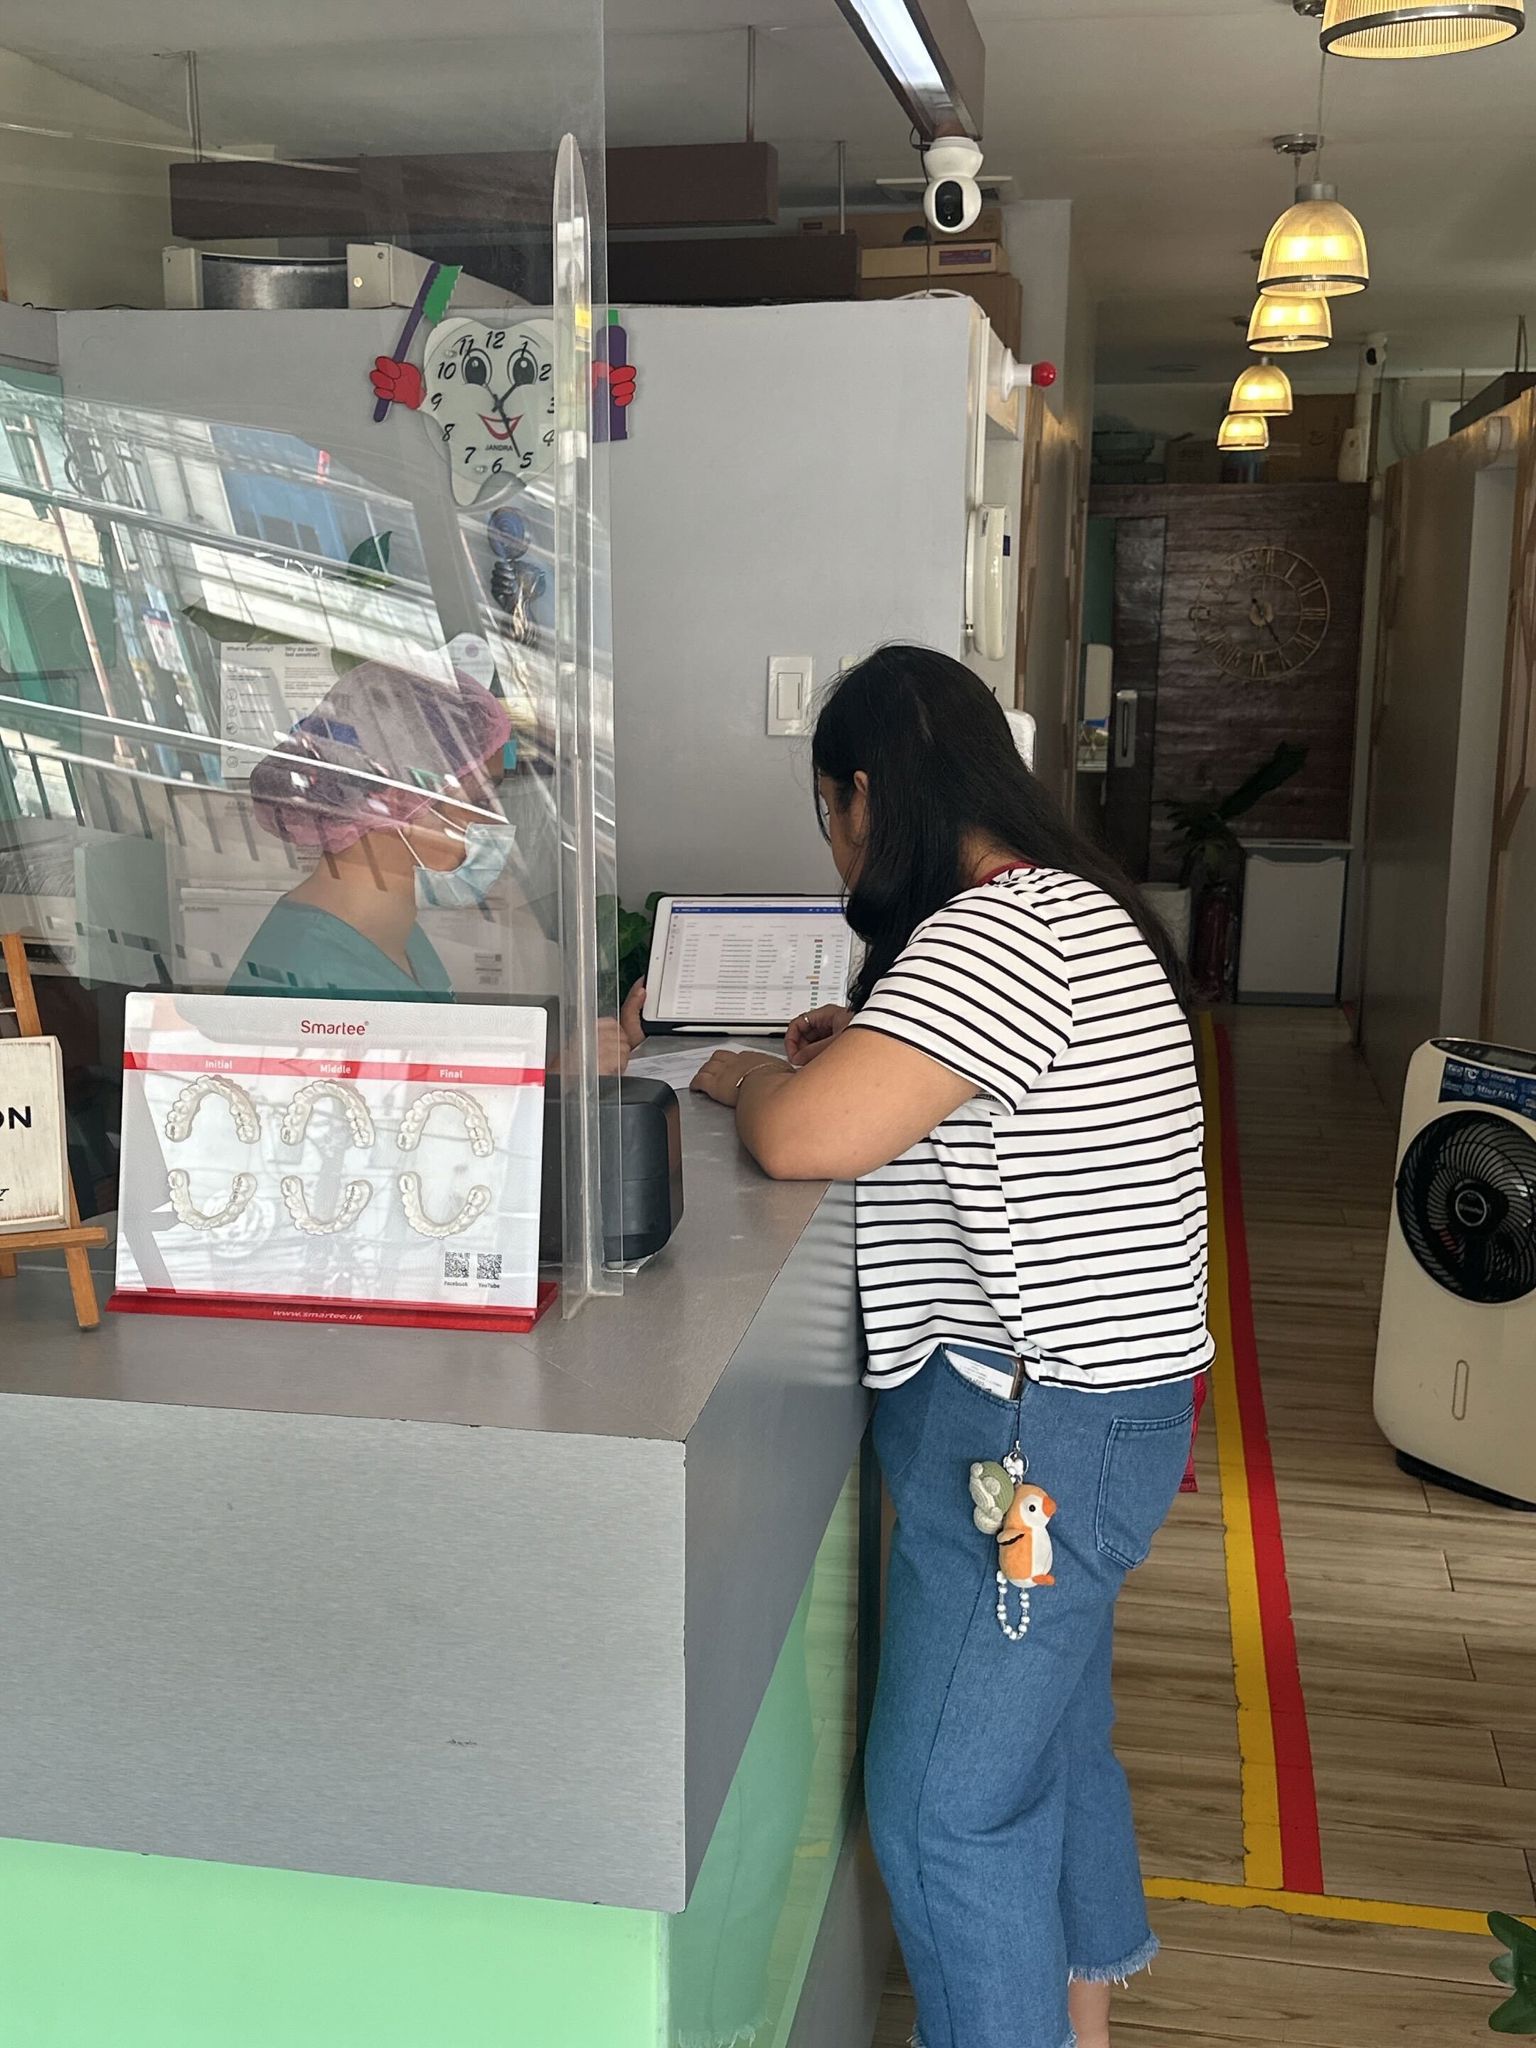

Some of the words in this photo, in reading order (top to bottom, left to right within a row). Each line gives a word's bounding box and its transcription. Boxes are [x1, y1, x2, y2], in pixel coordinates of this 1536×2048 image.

[458, 338, 474, 356] 11
[485, 331, 506, 349] 12
[520, 341, 529, 360] 1
[437, 362, 457, 380] 10
[538, 363, 552, 382] 2
[431, 392, 442, 411] 9
[442, 423, 455, 442] 8
[543, 429, 555, 446] 4
[464, 446, 476, 464] 7
[519, 451, 534, 469] 5
[491, 457, 503, 474] 6
[205, 1060, 233, 1069] Initial
[320, 1063, 351, 1074] Middle
[439, 1069, 464, 1079] Final
[0, 1106, 32, 1129] N
[273, 1310, 364, 1321] www.smartee.uk
